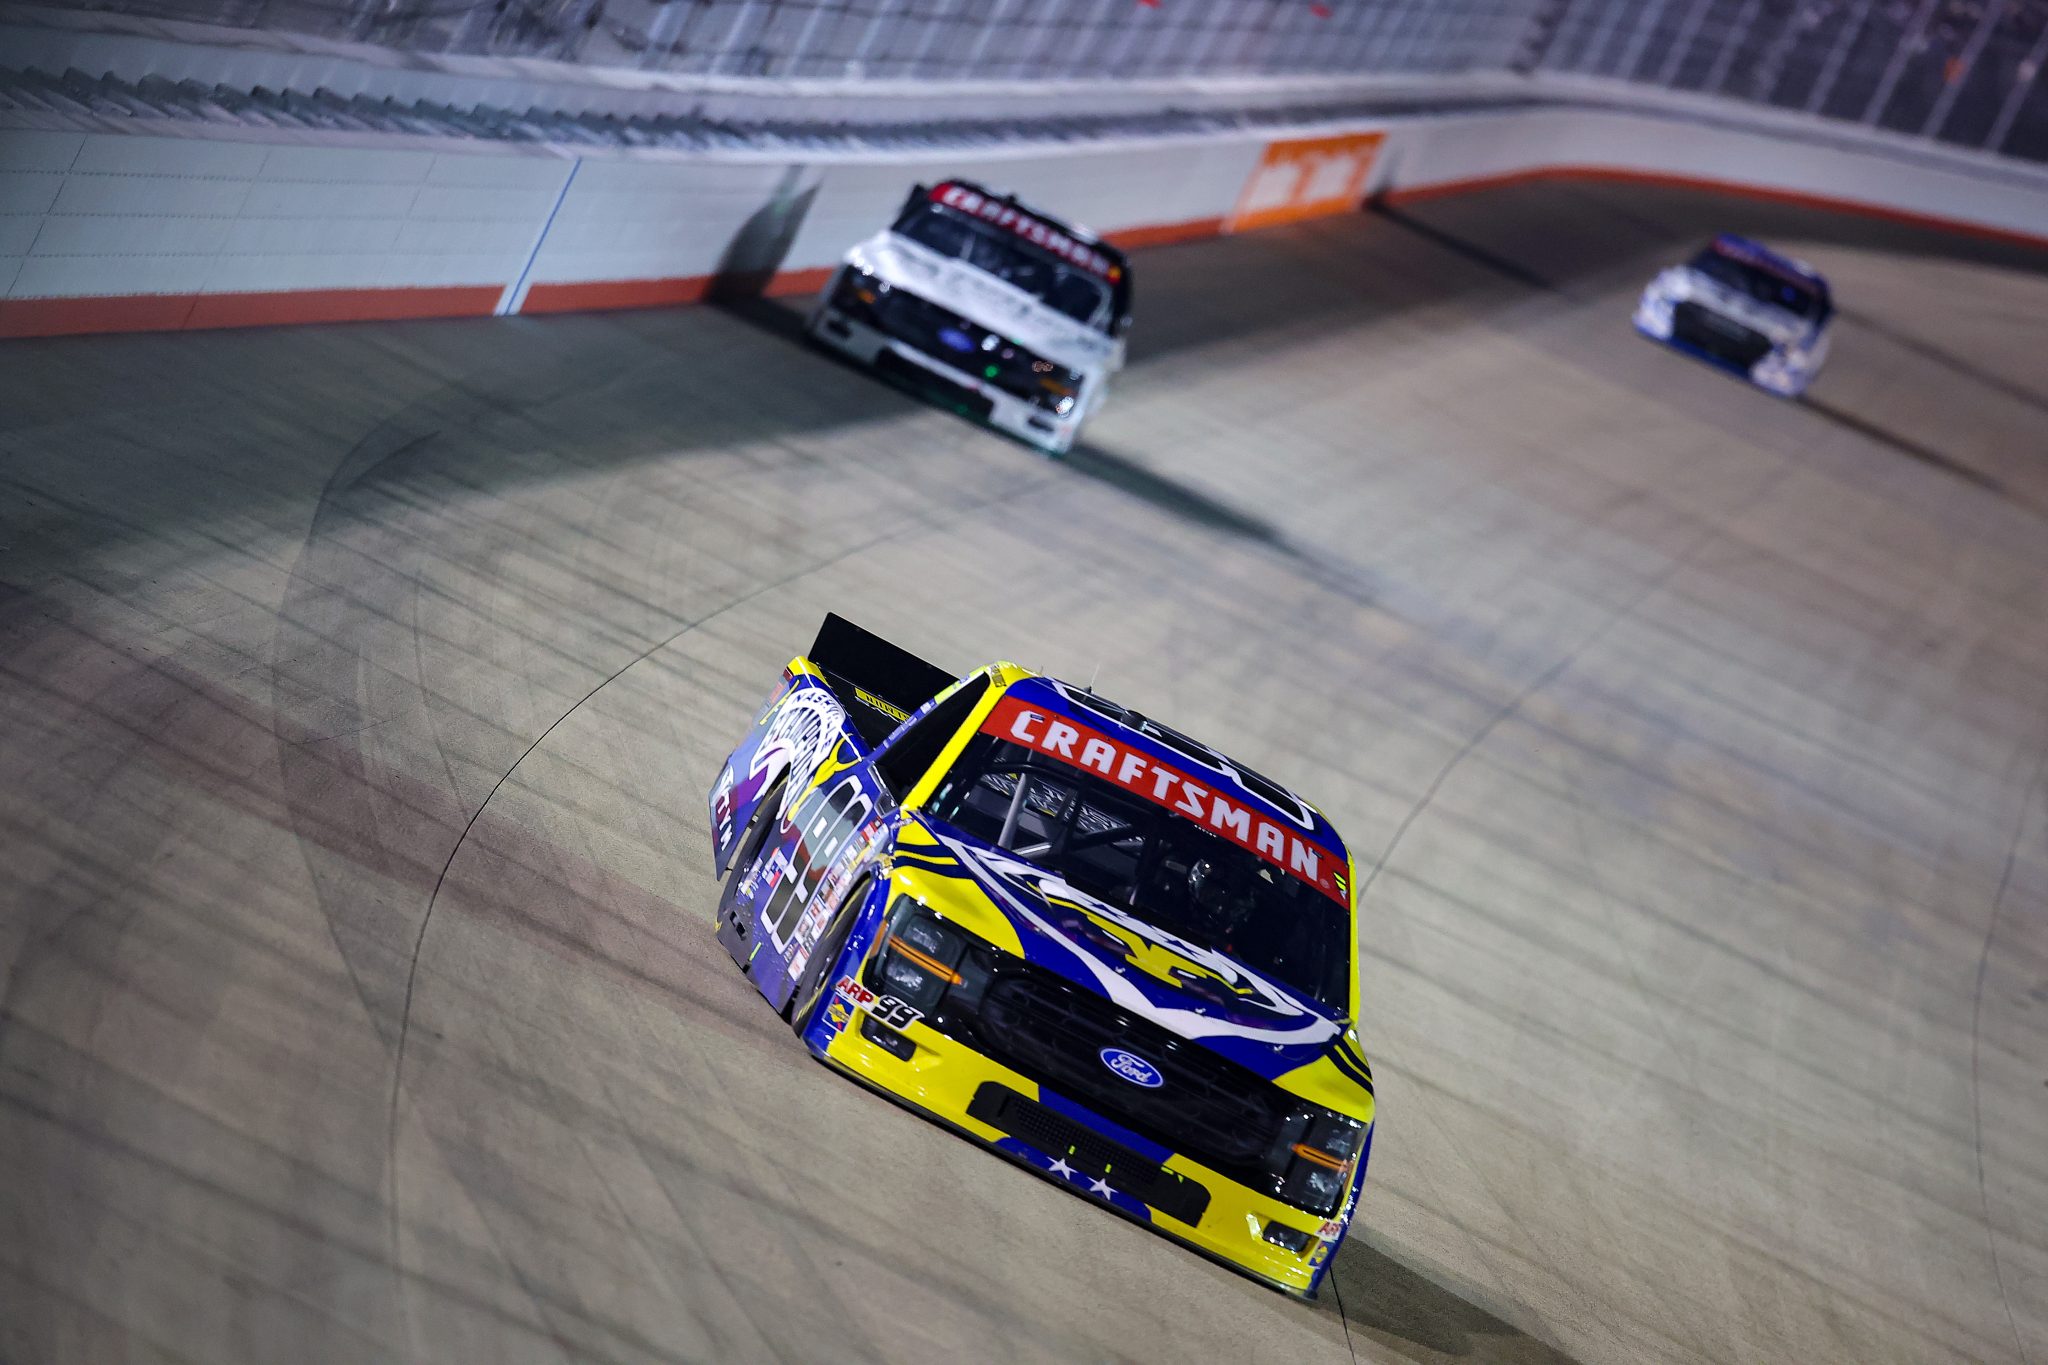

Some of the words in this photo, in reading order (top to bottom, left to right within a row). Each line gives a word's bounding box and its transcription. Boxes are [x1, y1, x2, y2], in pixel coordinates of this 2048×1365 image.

[1010, 710, 1319, 882] CRAFTSMAN
[837, 977, 874, 1004] ARP
[872, 995, 921, 1030] 99
[1110, 1053, 1153, 1083] Ford
